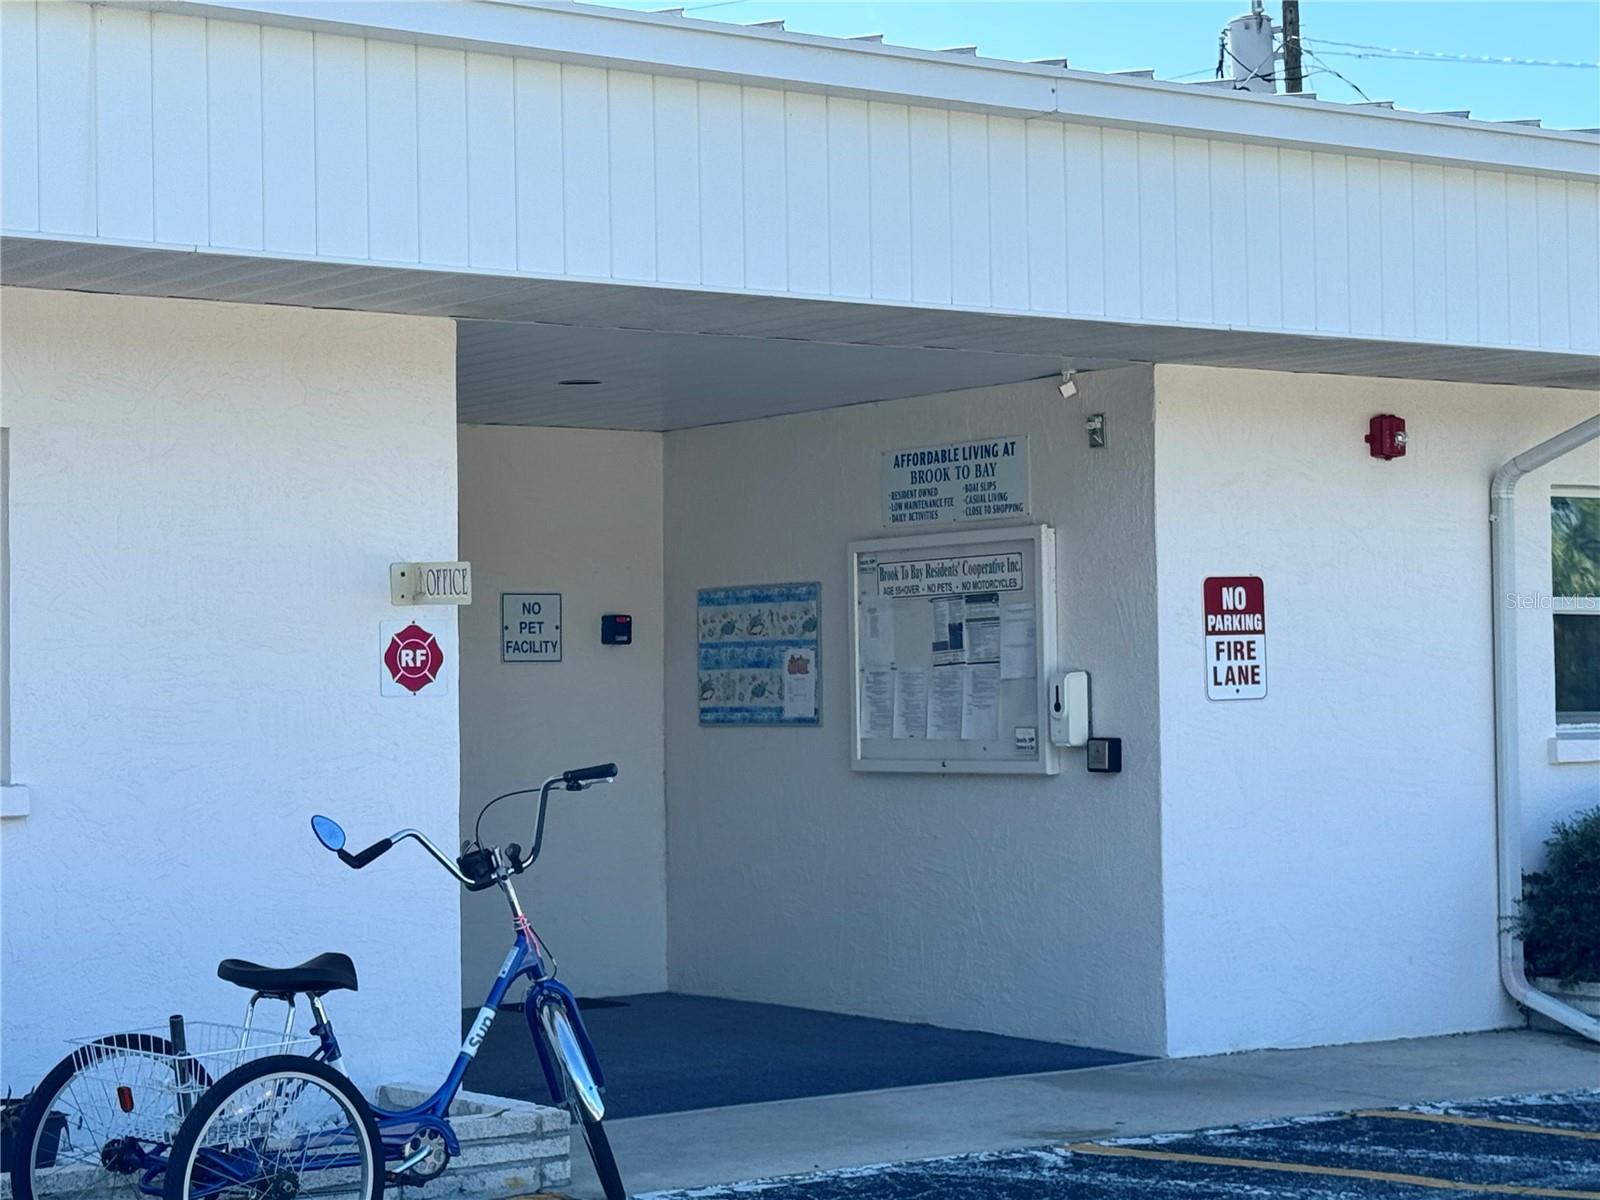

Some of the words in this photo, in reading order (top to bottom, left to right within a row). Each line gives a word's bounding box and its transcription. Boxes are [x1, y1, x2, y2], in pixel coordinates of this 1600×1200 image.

[893, 447, 959, 469] AFFORDABLE
[962, 443, 999, 461] LIVING
[1002, 441, 1016, 457] AT
[910, 467, 951, 485] BROOK
[955, 465, 970, 480] TO
[975, 462, 998, 478] BAY
[891, 489, 917, 500] RESIDENT
[918, 487, 939, 498] OWNED
[964, 483, 979, 493] BOAT
[980, 481, 997, 492] SLIPS
[891, 502, 903, 512] LOW
[904, 499, 943, 511] MAINTENANCE
[944, 497, 954, 507] FEE
[965, 495, 986, 505] CASUAL
[988, 492, 1008, 502] LIVING
[891, 514, 907, 523] DAILY
[908, 510, 939, 521] ACTIVITIES
[965, 506, 983, 516] CLOSE
[984, 505, 992, 515] TO
[993, 502, 1024, 514] SHOPPING
[879, 567, 899, 582] Brook
[900, 565, 910, 580] To
[910, 564, 924, 582] Bay
[925, 561, 960, 578] Residents'
[962, 559, 1005, 579] Cooperative
[1006, 557, 1021, 573] Inc.
[426, 568, 468, 596] OFFICE
[883, 586, 894, 596] AGE
[927, 583, 936, 593] NO
[936, 582, 953, 593] PETS
[961, 580, 972, 591] NO
[972, 578, 1018, 590] MOTORCYCLES
[1222, 586, 1247, 611] NO
[522, 602, 541, 616] NO
[519, 621, 544, 635] PET
[1207, 613, 1263, 632] PARKING
[505, 640, 558, 654] FACILITY
[1215, 640, 1257, 661] FIRE
[400, 649, 427, 668] RF
[1213, 664, 1261, 687] LANE
[469, 1016, 493, 1046] Sun
